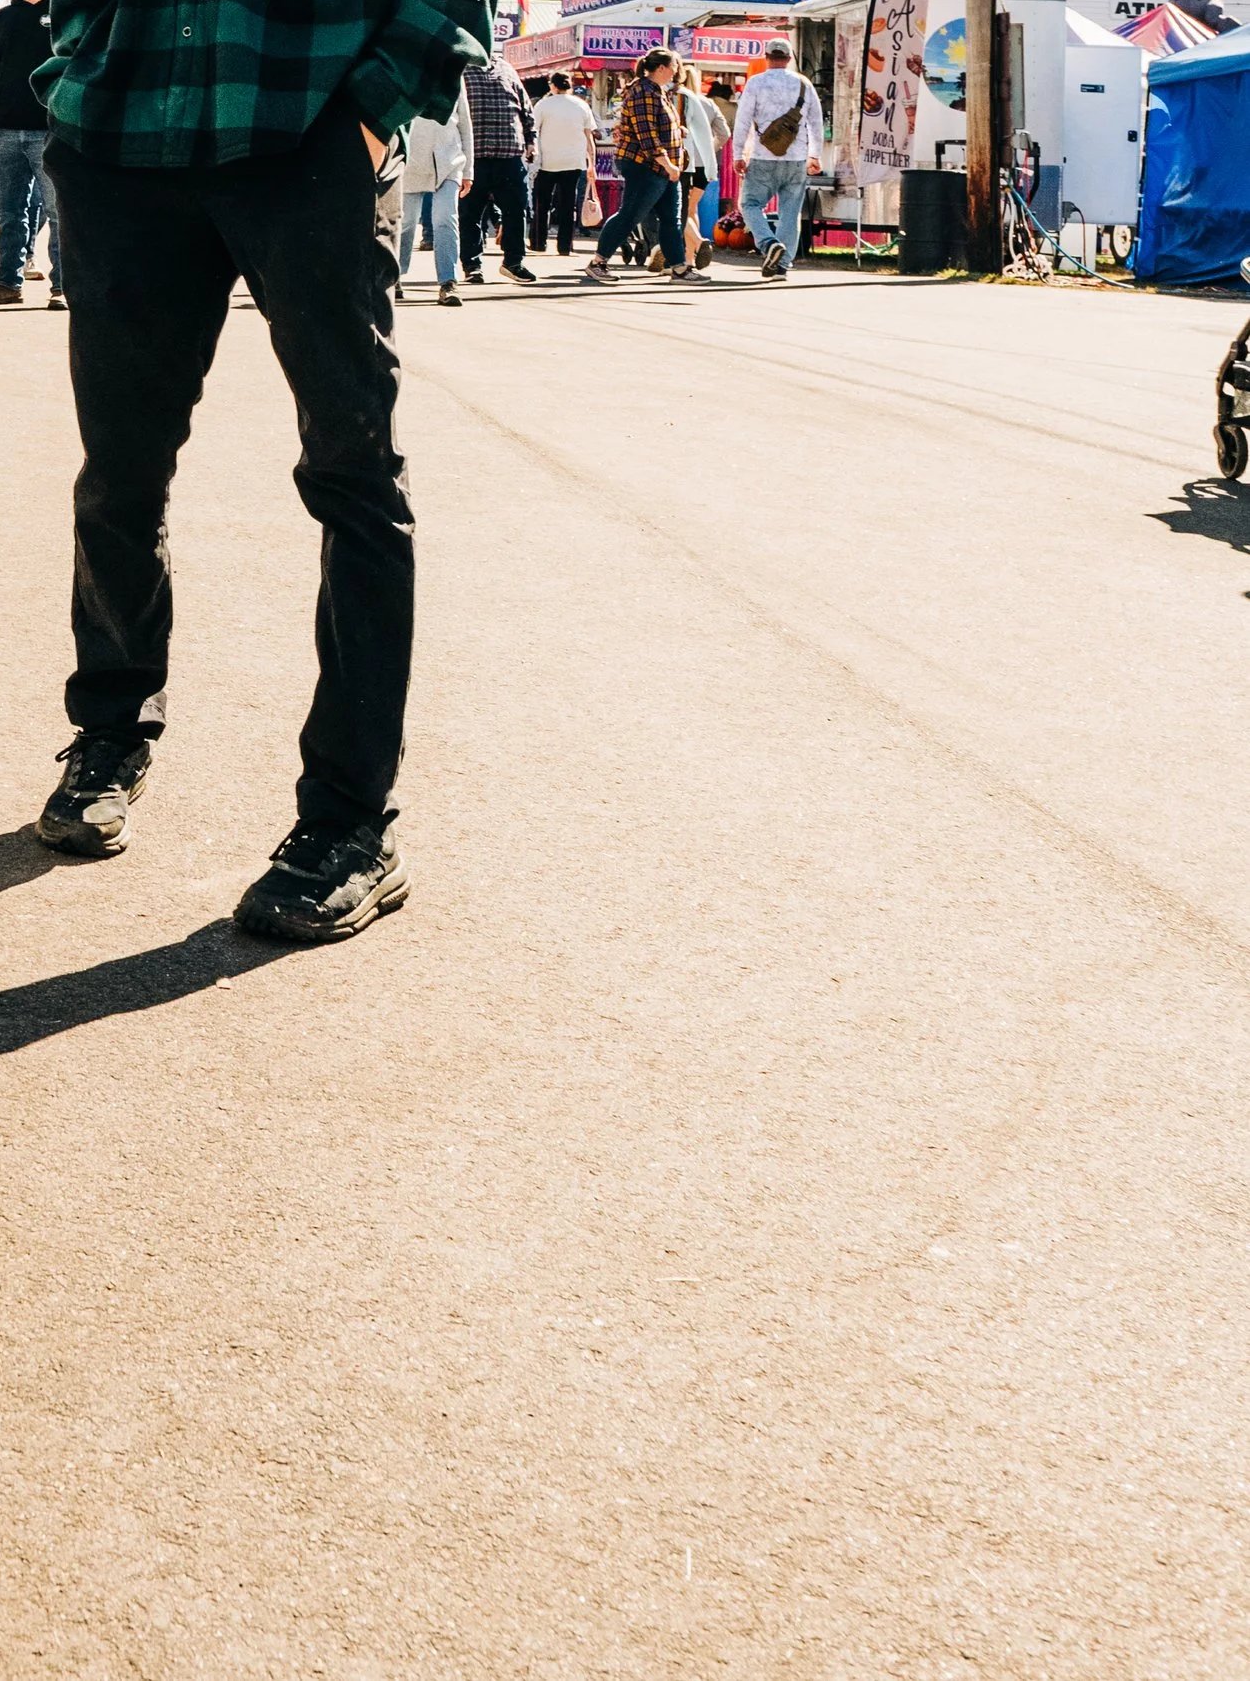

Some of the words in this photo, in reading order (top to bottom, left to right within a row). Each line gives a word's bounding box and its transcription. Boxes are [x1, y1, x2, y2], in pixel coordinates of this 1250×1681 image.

[587, 36, 662, 51] DRINKS
[695, 37, 761, 56] FRIED
[872, 130, 895, 148] BOBA
